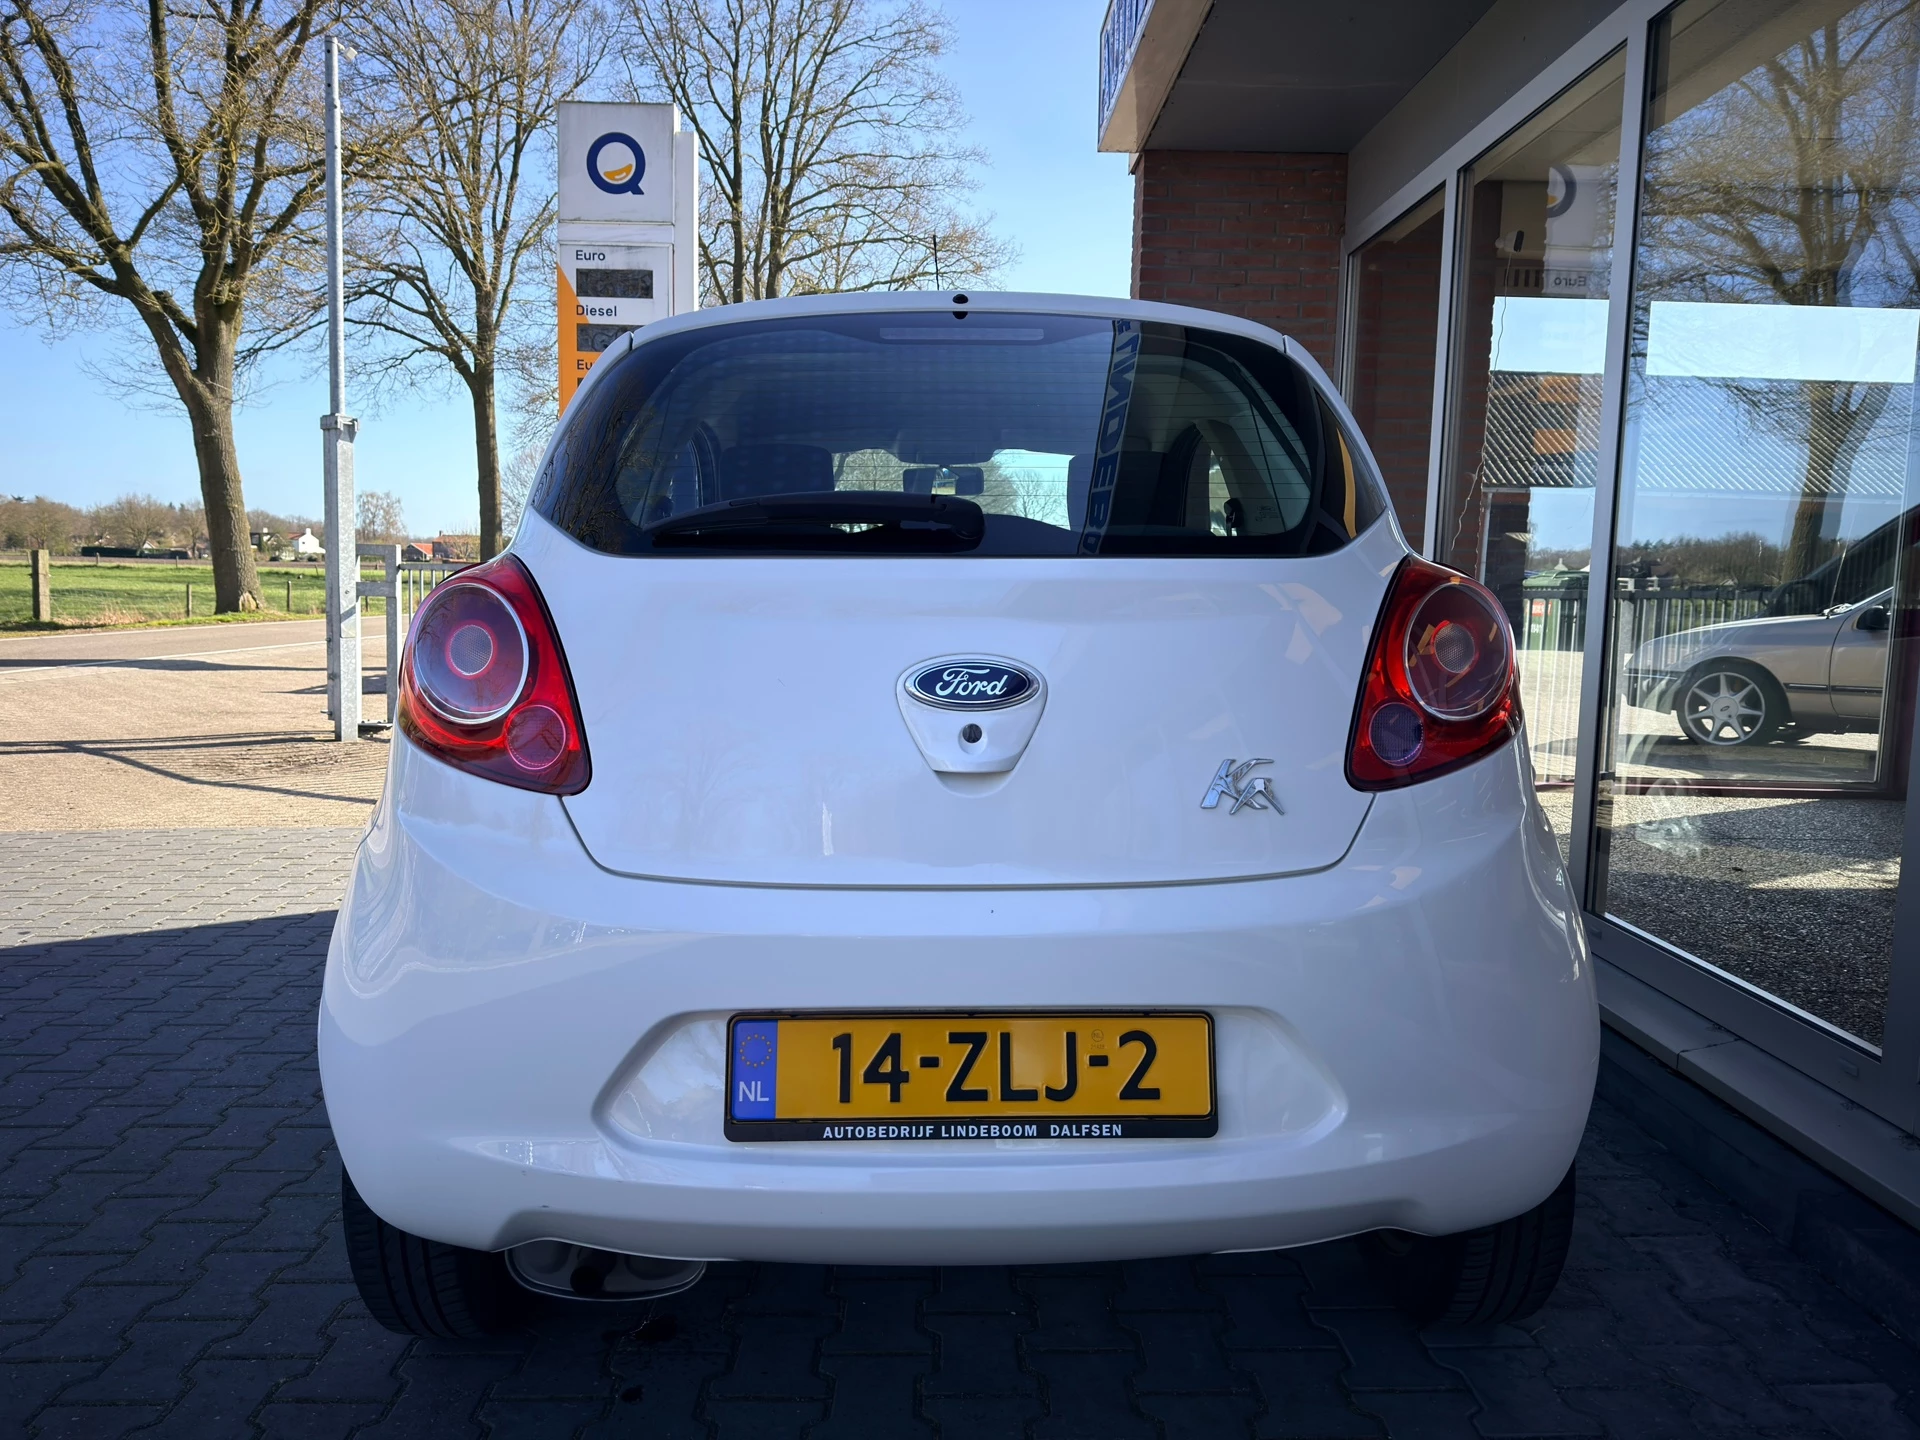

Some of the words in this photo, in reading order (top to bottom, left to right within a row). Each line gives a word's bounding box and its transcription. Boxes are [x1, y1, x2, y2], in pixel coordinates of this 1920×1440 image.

[586, 131, 646, 195] Q
[575, 249, 606, 261] Euro
[575, 304, 617, 317] Diesel
[576, 359, 593, 371] Eu
[935, 667, 1008, 697] Ford
[831, 1029, 1161, 1104] 14-ZLJ-2
[738, 1080, 770, 1102] NL
[822, 1125, 935, 1139] AUTOBEDRIJF
[941, 1124, 1038, 1138] LINDEBOOM
[1050, 1123, 1123, 1137] DALFSEN
